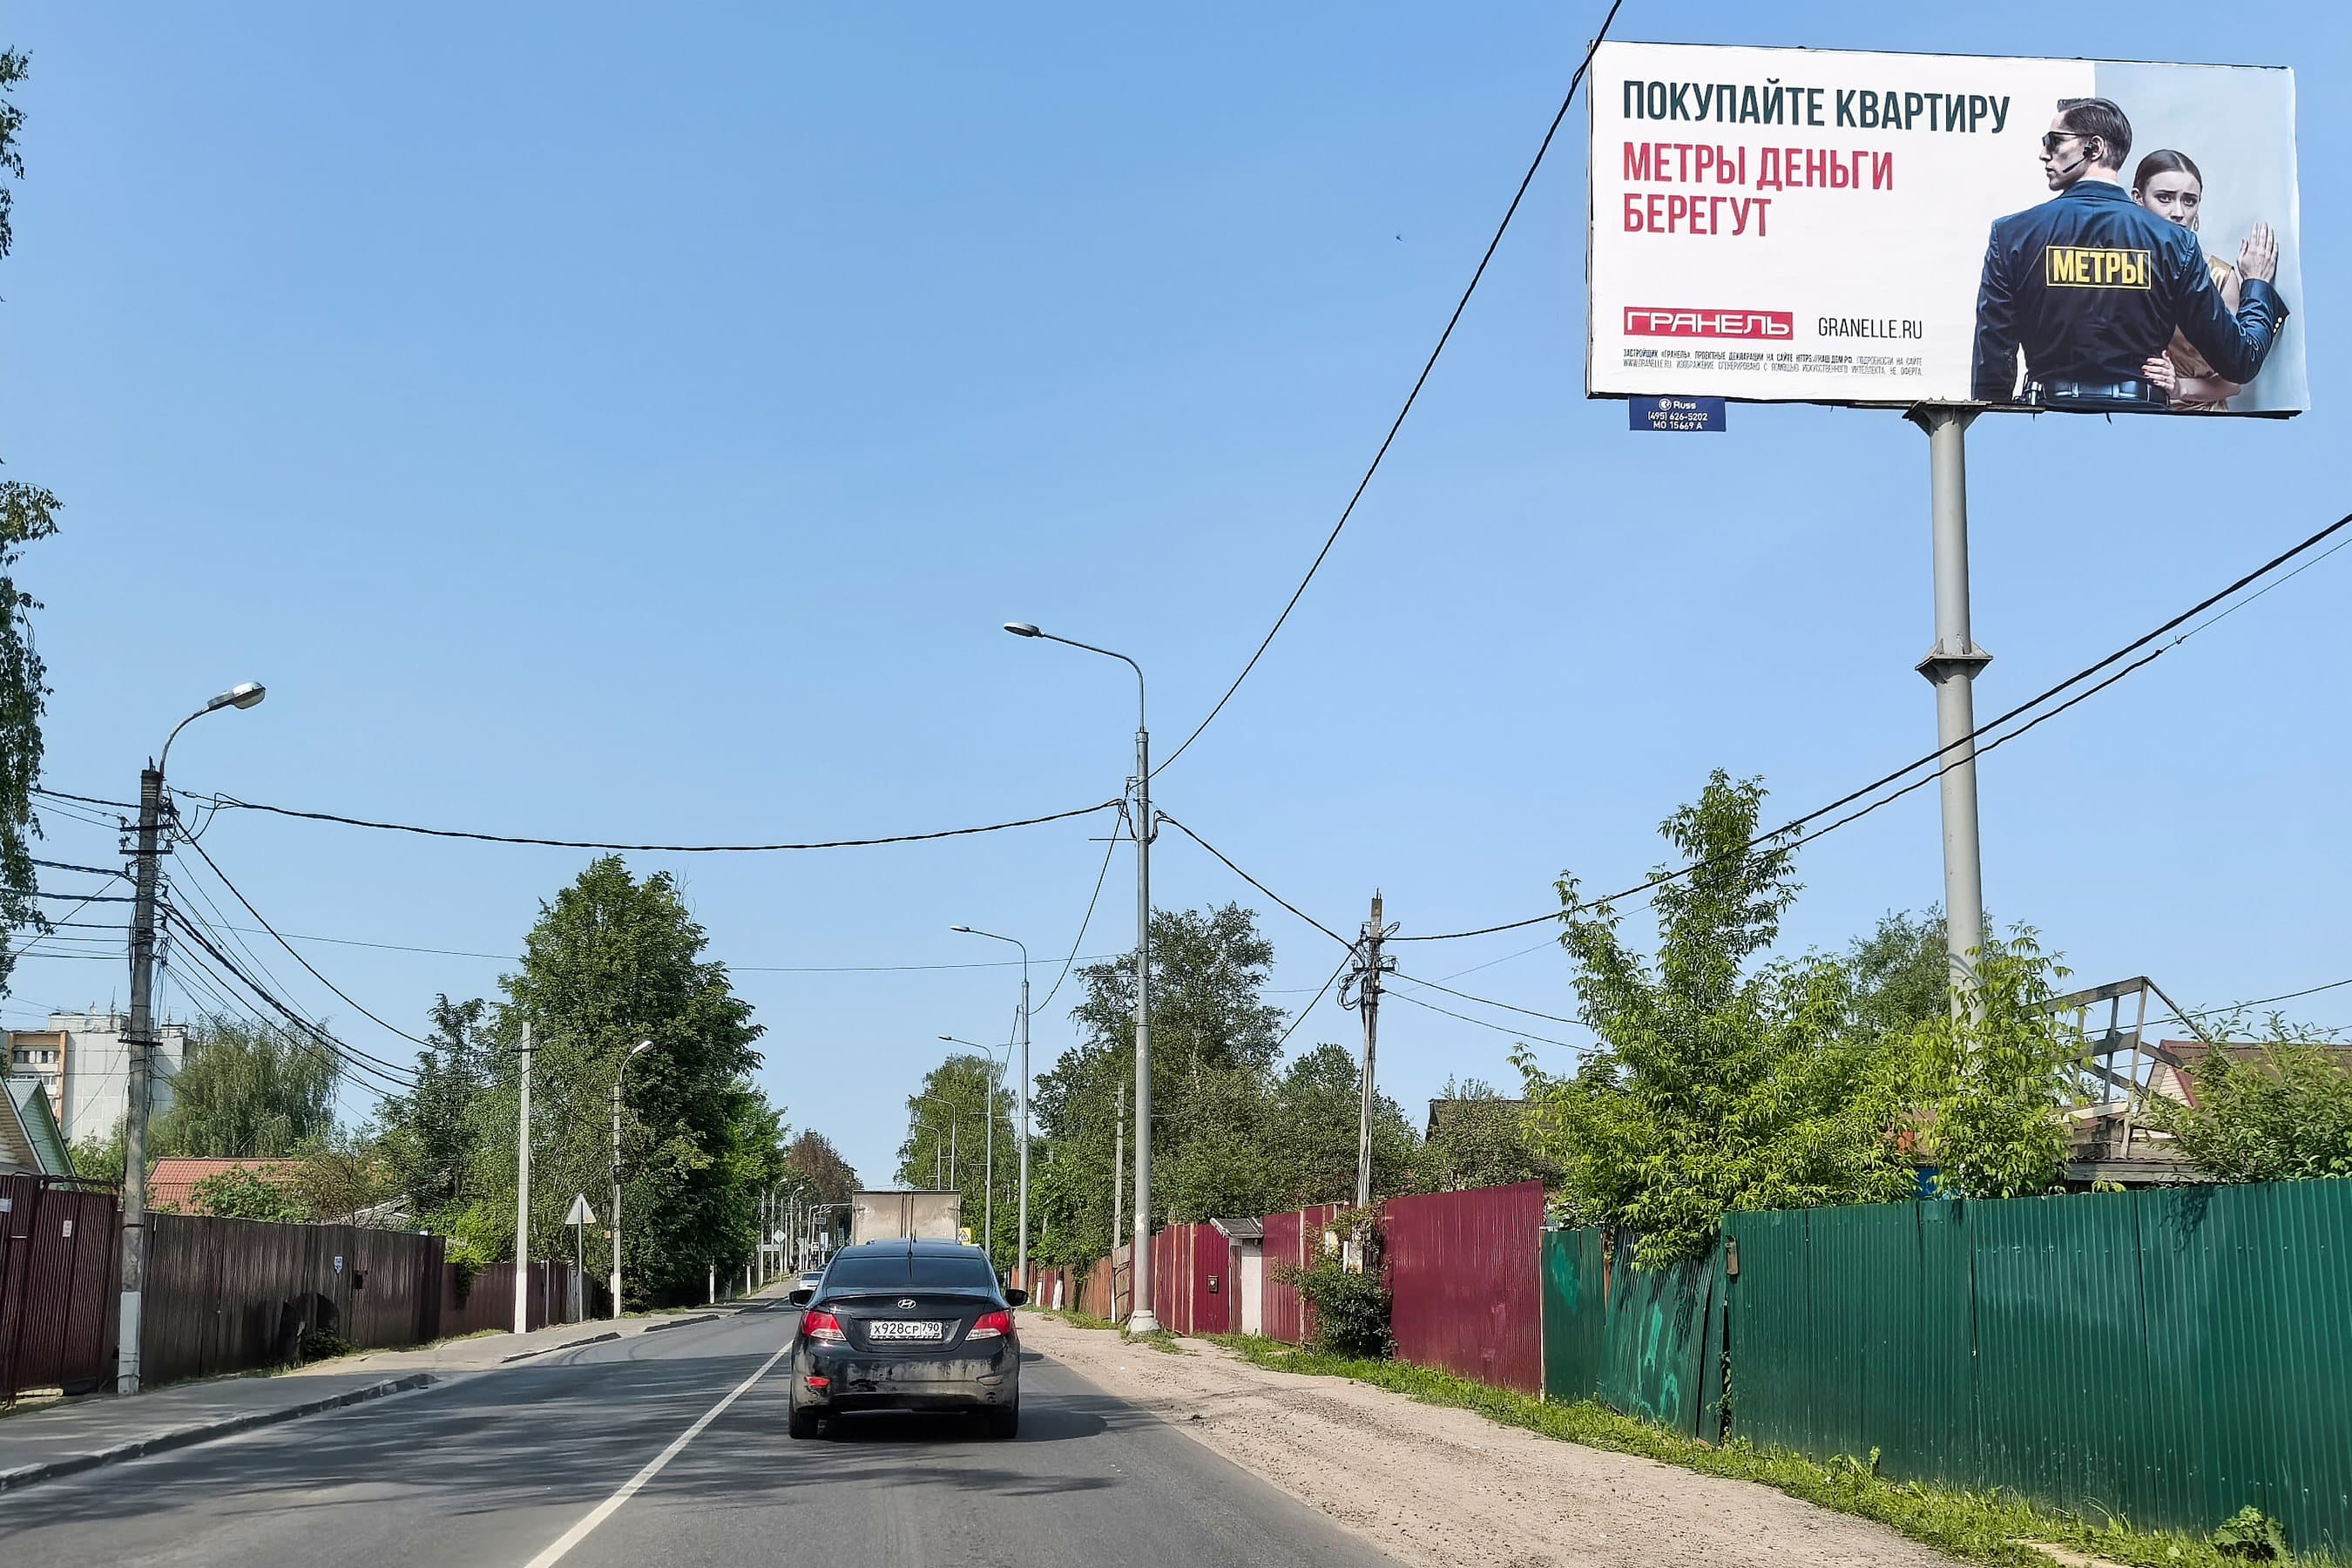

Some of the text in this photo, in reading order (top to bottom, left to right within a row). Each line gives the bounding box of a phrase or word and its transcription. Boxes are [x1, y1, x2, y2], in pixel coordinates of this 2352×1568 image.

[1623, 78, 2011, 134] ПОКУПАЙТЕ КВАРТИРУ
[1623, 142, 1894, 192] МЕТРЫ ДЕНЬГИ
[1623, 193, 1772, 237] БЕРЕГУТ
[2053, 249, 2145, 285] МЕТРЫ
[1626, 311, 1790, 335] ГРАНЕЛЬ
[1817, 317, 1923, 340] GRANELLE.RU
[1623, 348, 1659, 358] ЗАСТРОЙЩИК
[1694, 351, 1726, 360] ПРОЕКТНЫЕ
[1728, 352, 1764, 362] ДЕКЛАРАЦИИ
[1767, 353, 1774, 362] НА
[1776, 352, 1793, 362] САЙТЕ
[1856, 355, 1894, 366] ПОДРОБНОСТИ
[1896, 356, 1904, 366] НА
[1906, 356, 1923, 367] САЙТЕ
[1676, 361, 1714, 370] ИЗОБРАЖЕНИЕ
[1647, 411, 1707, 422] (495) 626-5202
[1673, 401, 1697, 409] Russ
[922, 1322, 940, 1332] 790
